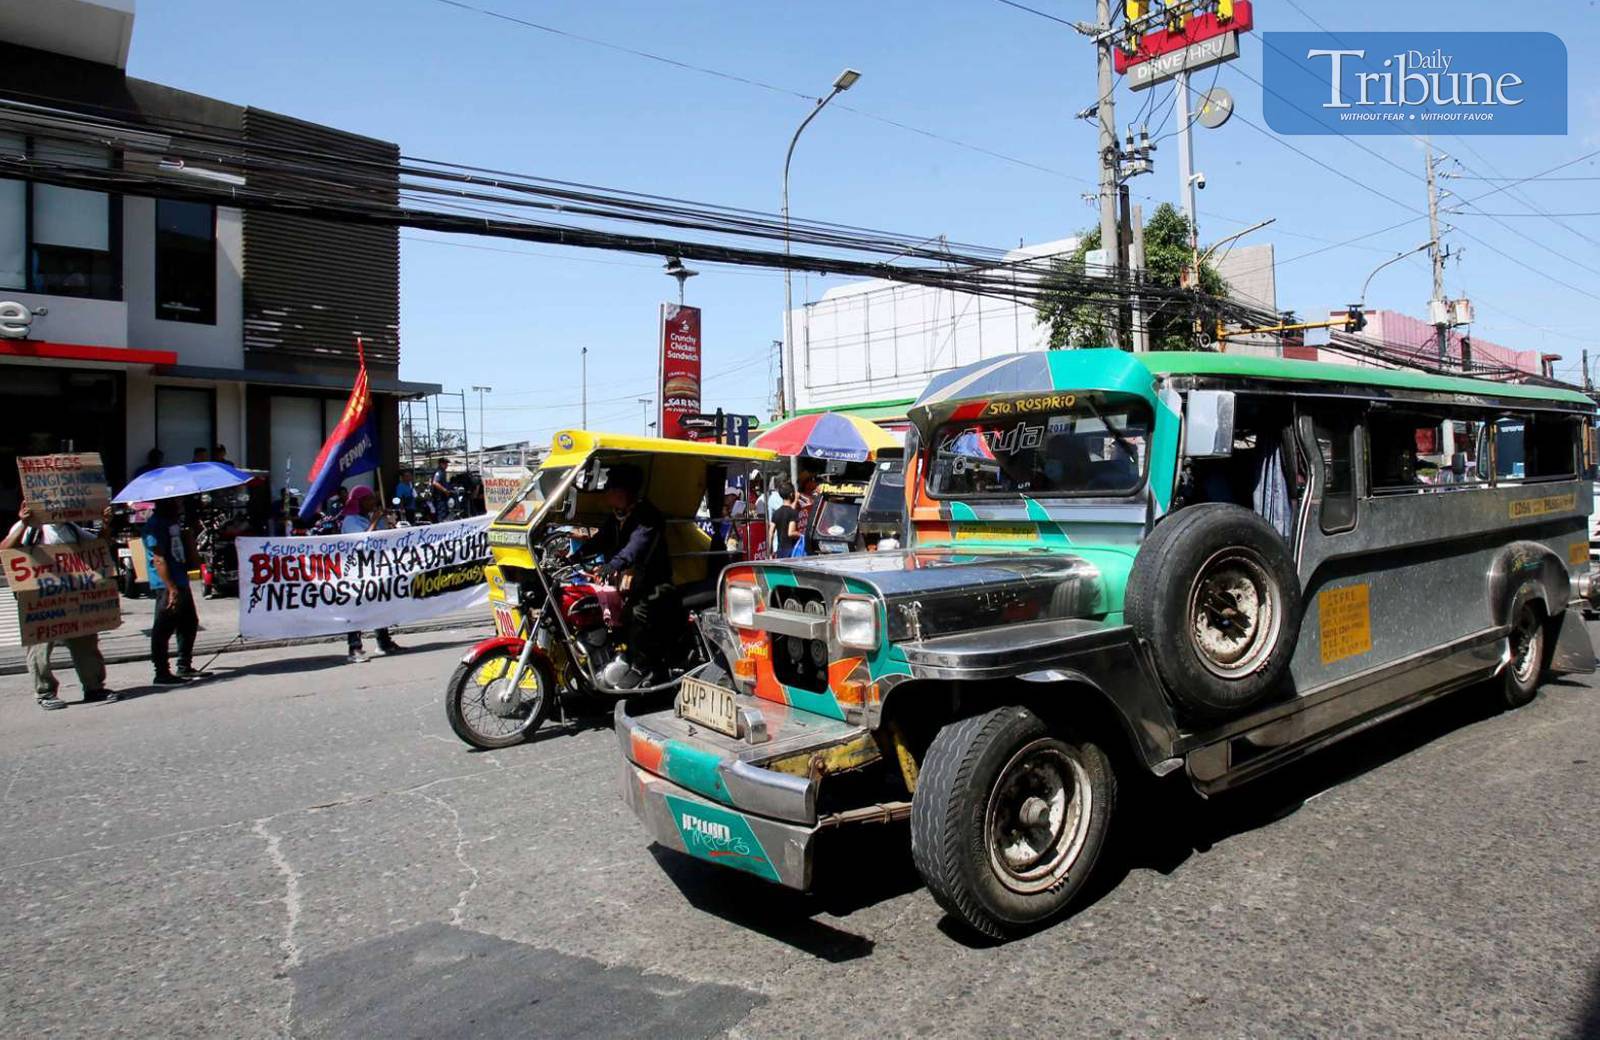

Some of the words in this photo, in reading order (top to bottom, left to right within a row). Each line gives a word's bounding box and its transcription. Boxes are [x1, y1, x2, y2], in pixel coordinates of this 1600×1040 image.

[1137, 51, 1184, 79] DRIVE
[670, 333, 697, 346] Crunchy
[670, 342, 697, 352] Chicken
[667, 350, 699, 361] Sandwich
[10, 556, 32, 582] 5
[248, 551, 342, 585] BIGUIN
[266, 573, 409, 612] NEGOSYONG
